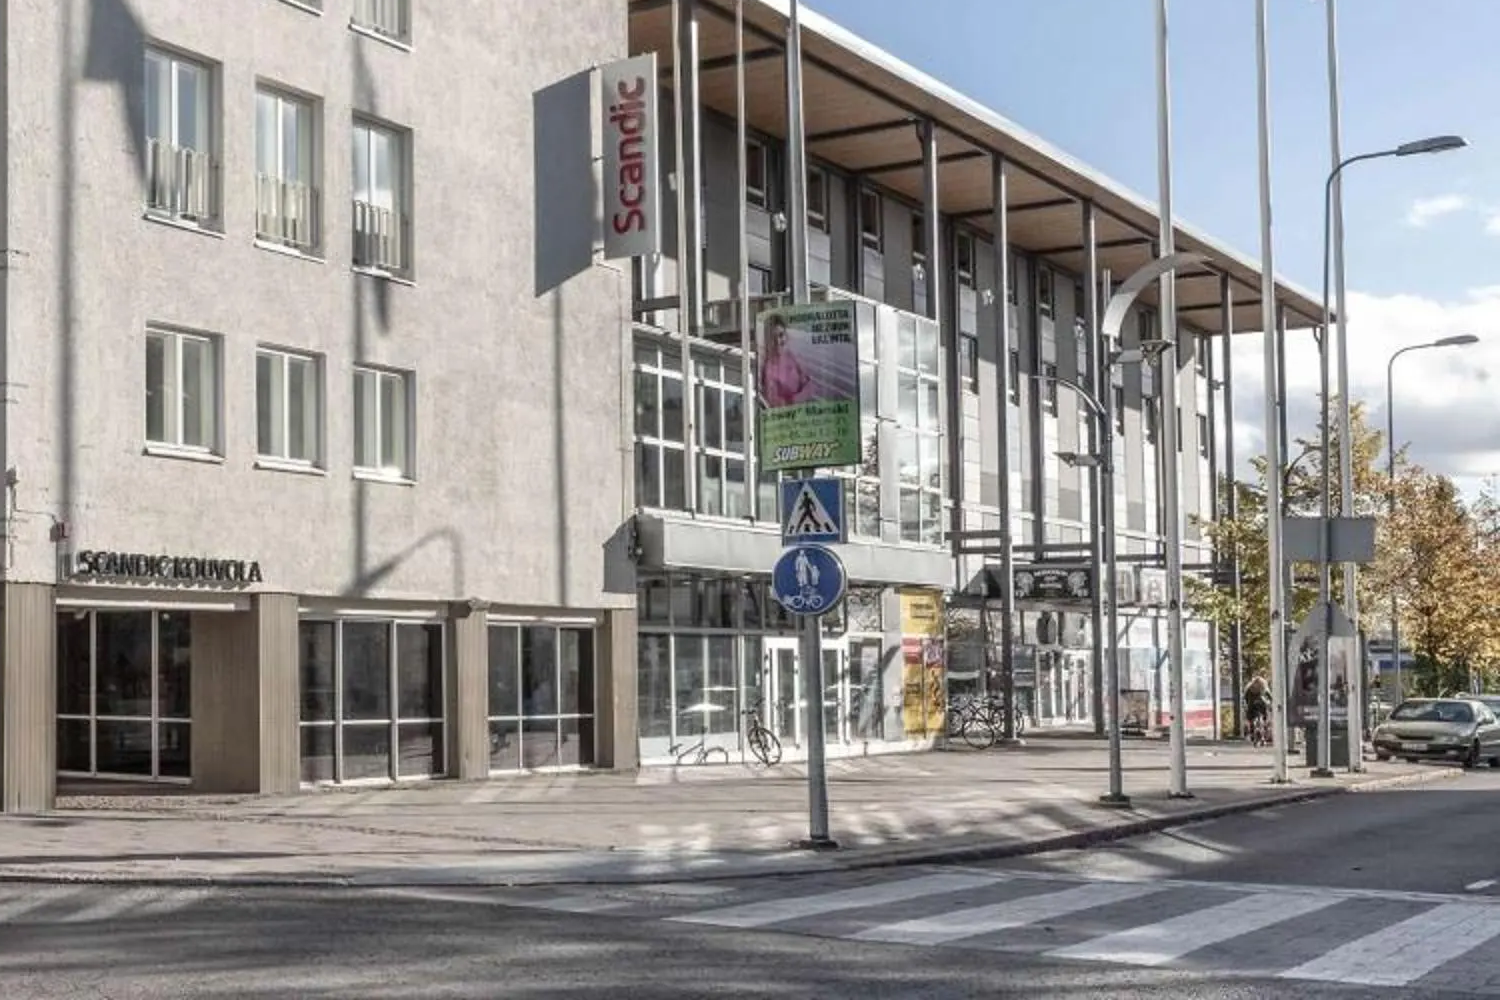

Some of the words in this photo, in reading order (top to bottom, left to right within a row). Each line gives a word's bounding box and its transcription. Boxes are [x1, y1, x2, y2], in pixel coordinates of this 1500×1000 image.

[609, 76, 647, 235] Scandic
[772, 441, 837, 463] SUBWAY
[78, 550, 171, 577] SCANDIC
[173, 555, 263, 582] KOUVOLA
